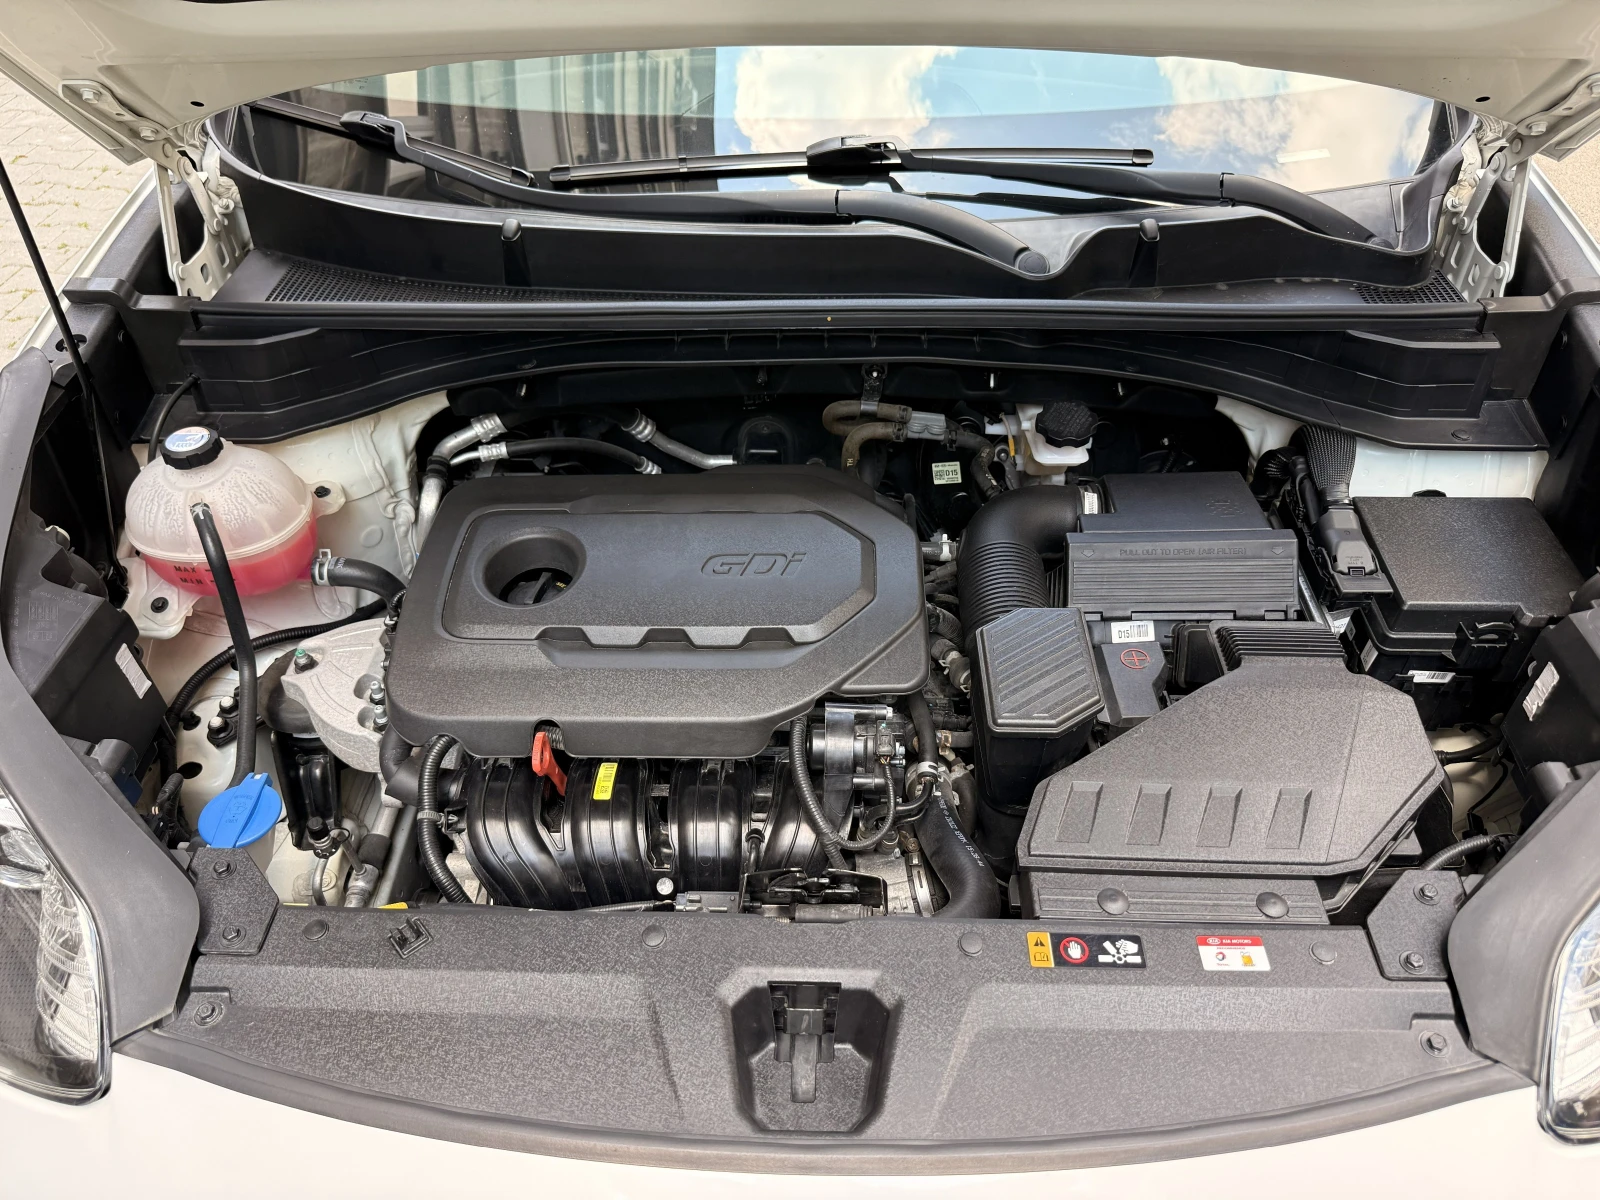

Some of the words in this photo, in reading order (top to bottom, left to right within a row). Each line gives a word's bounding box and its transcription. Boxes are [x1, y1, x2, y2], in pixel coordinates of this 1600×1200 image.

[1141, 548, 1158, 556] OUT
[1159, 548, 1171, 556] TO
[1172, 548, 1195, 556] OPEN
[174, 565, 197, 573] MAX
[1118, 630, 1130, 638] D15
